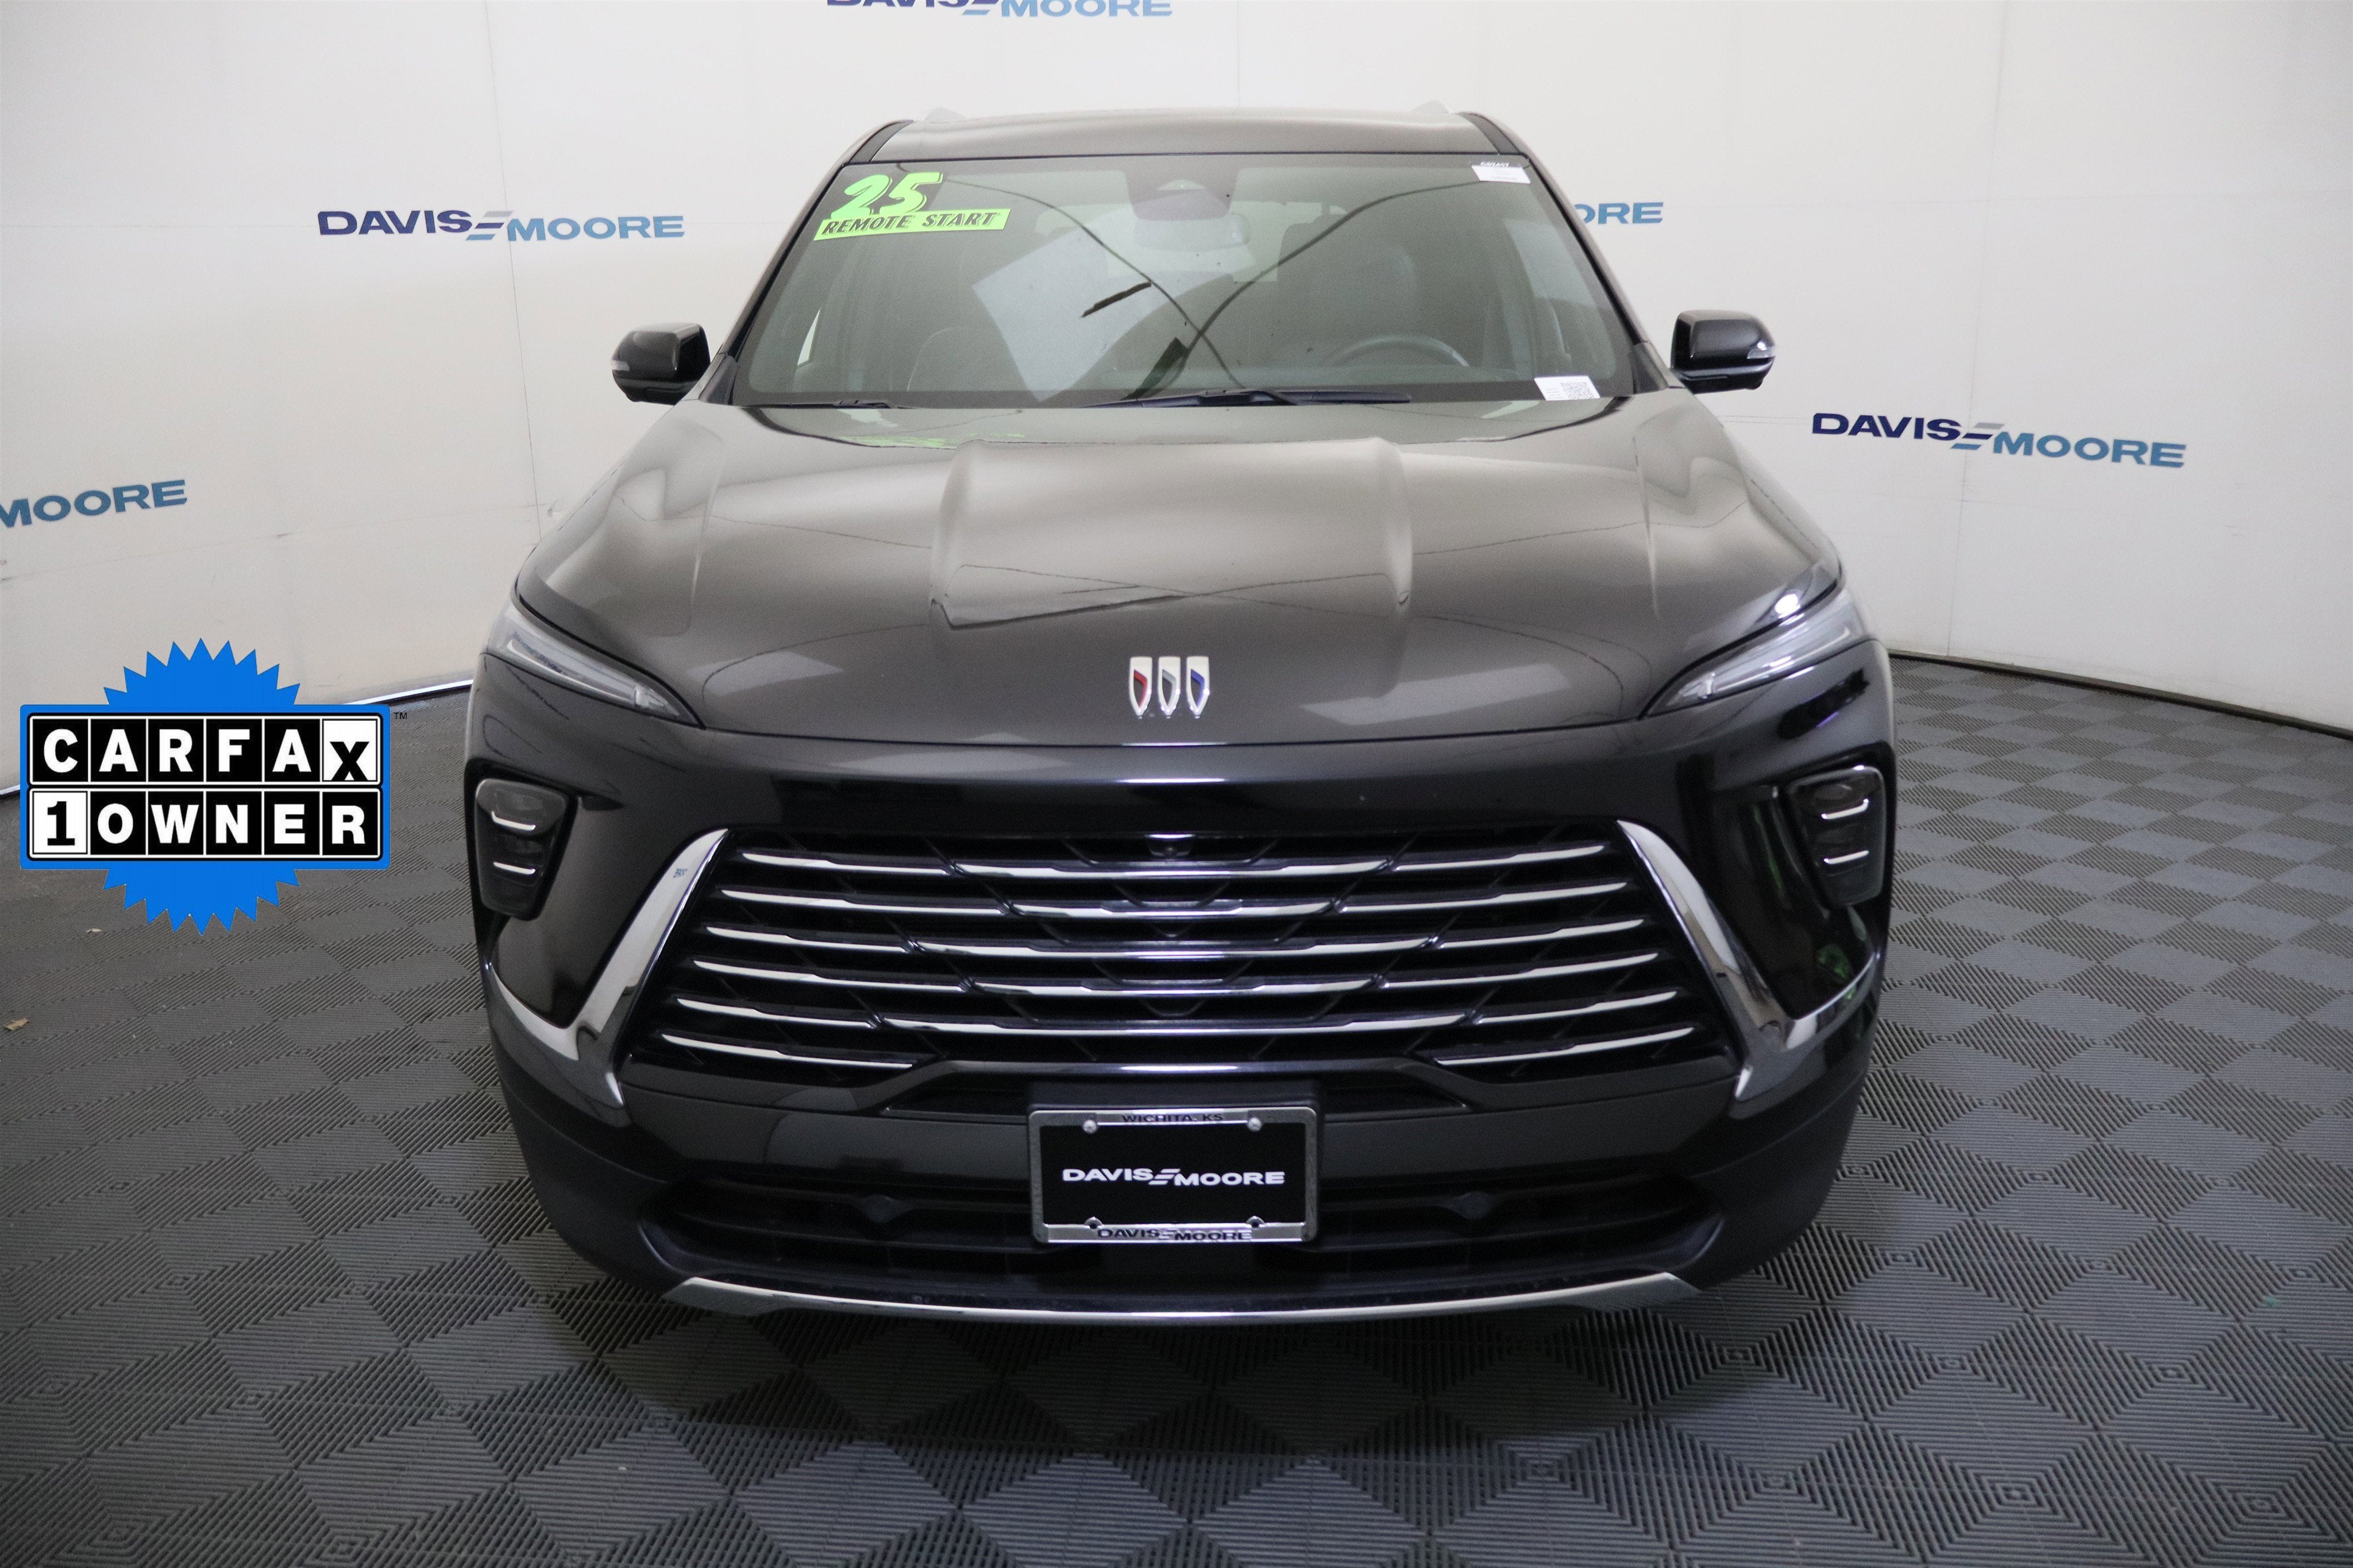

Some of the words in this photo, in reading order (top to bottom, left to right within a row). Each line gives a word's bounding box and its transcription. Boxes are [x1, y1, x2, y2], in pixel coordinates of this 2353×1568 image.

[1001, 0, 1172, 17] MOORE
[831, 172, 943, 219] 25
[821, 214, 915, 235] REMOTE
[921, 212, 1000, 227] START
[1574, 202, 1664, 225] ORE
[318, 210, 473, 235] DAVIS
[507, 215, 684, 241] MOORE
[1812, 412, 1962, 441] DAVIS
[1993, 431, 2187, 469] MOORE
[0, 479, 187, 528] MOORE
[1203, 1113, 1223, 1121] KS
[1062, 1168, 1154, 1181] DAVIS
[1174, 1171, 1286, 1186] MOORE
[1097, 1229, 1159, 1238] DAVIS
[1175, 1231, 1252, 1241] MOORE
